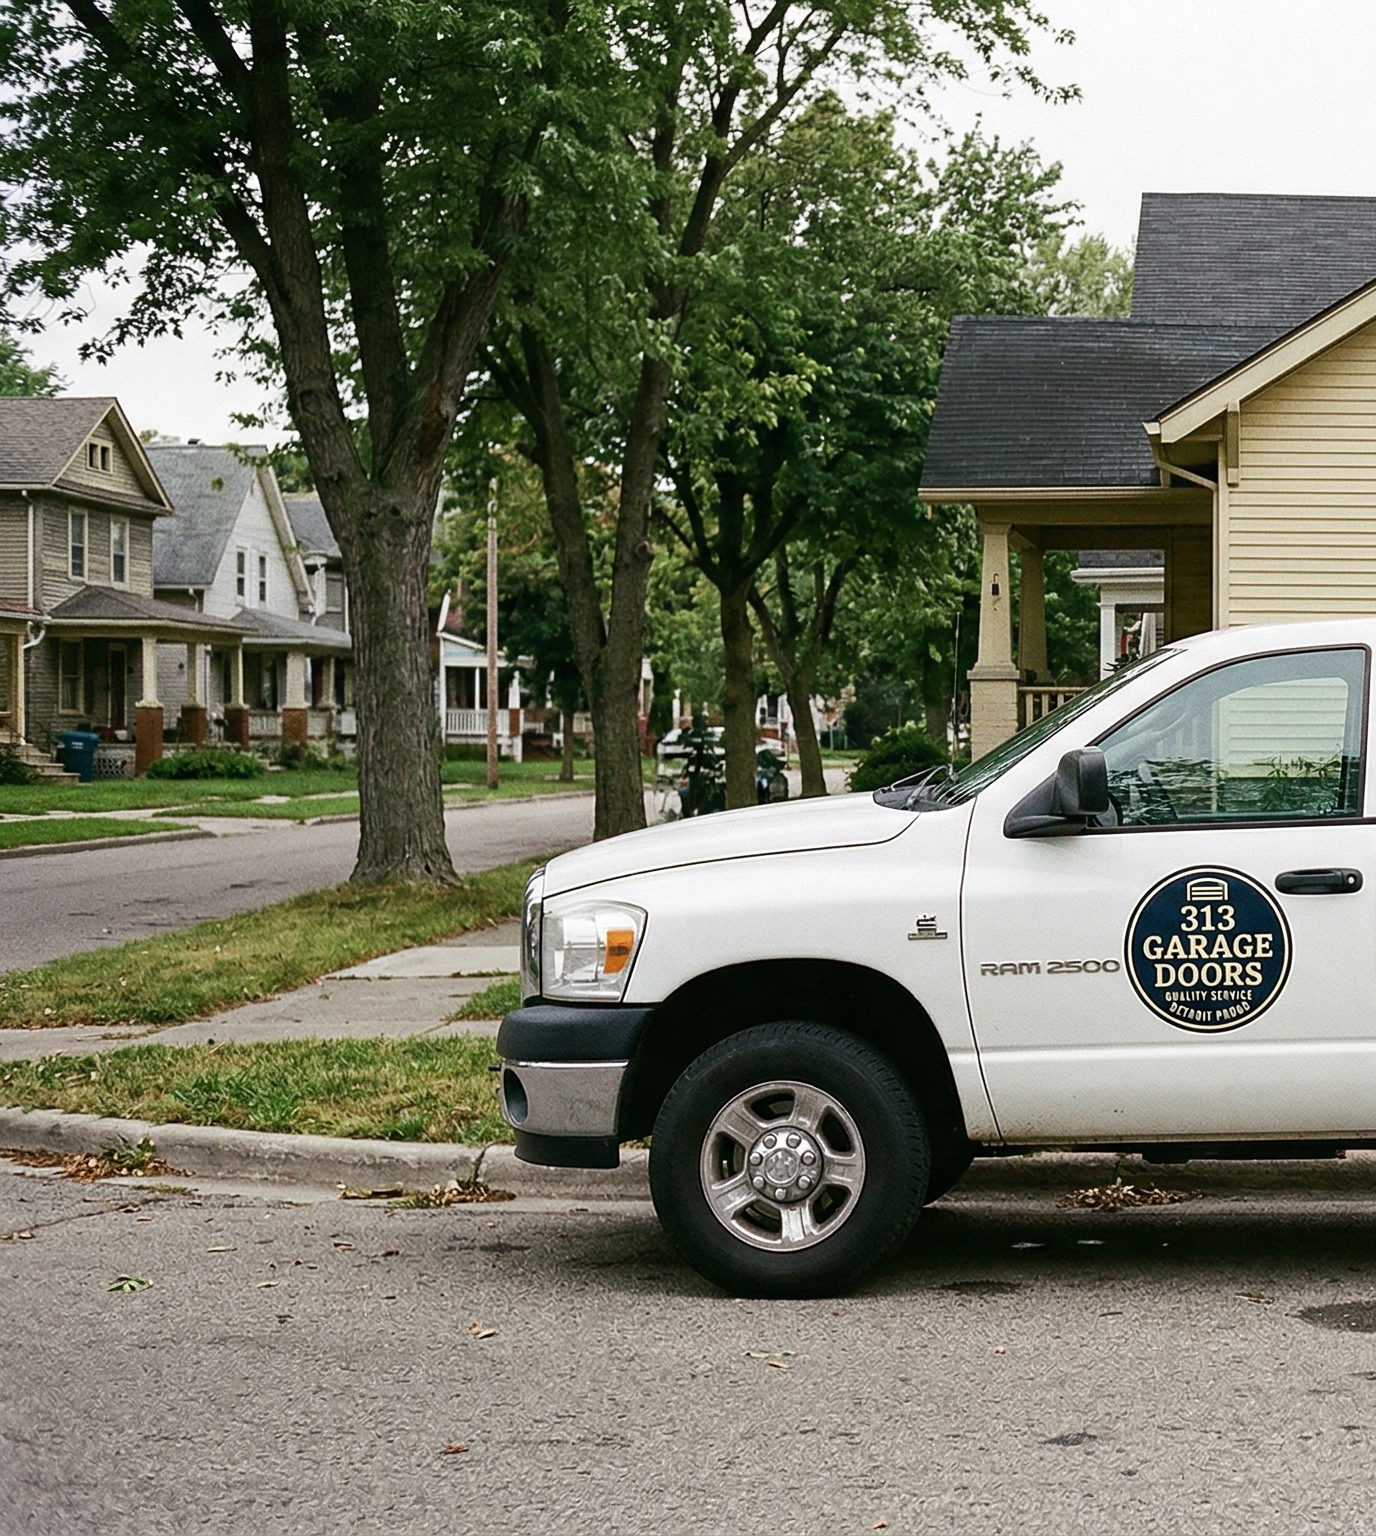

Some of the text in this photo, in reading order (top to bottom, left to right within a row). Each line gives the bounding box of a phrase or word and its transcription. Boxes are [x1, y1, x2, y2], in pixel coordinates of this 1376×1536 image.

[1180, 905, 1236, 932] 313
[1143, 933, 1273, 960] GARAGE
[980, 960, 1120, 976] RAM 2500
[1154, 962, 1263, 987] DOORS
